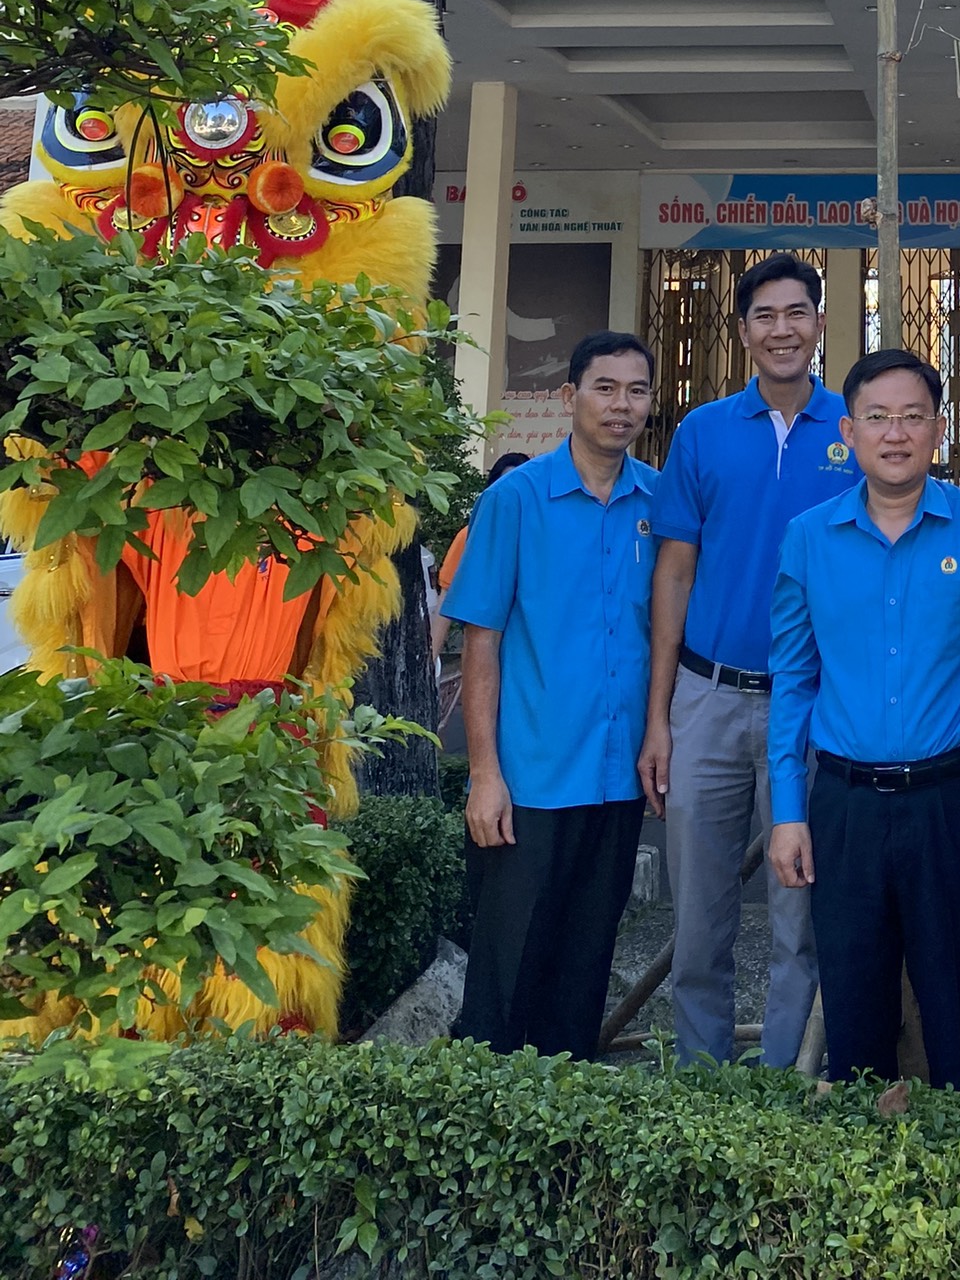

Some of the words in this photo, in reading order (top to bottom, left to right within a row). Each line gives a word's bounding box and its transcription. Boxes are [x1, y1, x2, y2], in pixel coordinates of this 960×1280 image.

[659, 195, 710, 225] SỐNG,
[716, 194, 766, 224] CHIẾN
[772, 195, 813, 226] ĐẤU,
[819, 203, 850, 224] LAO
[908, 197, 931, 223] VÀ
